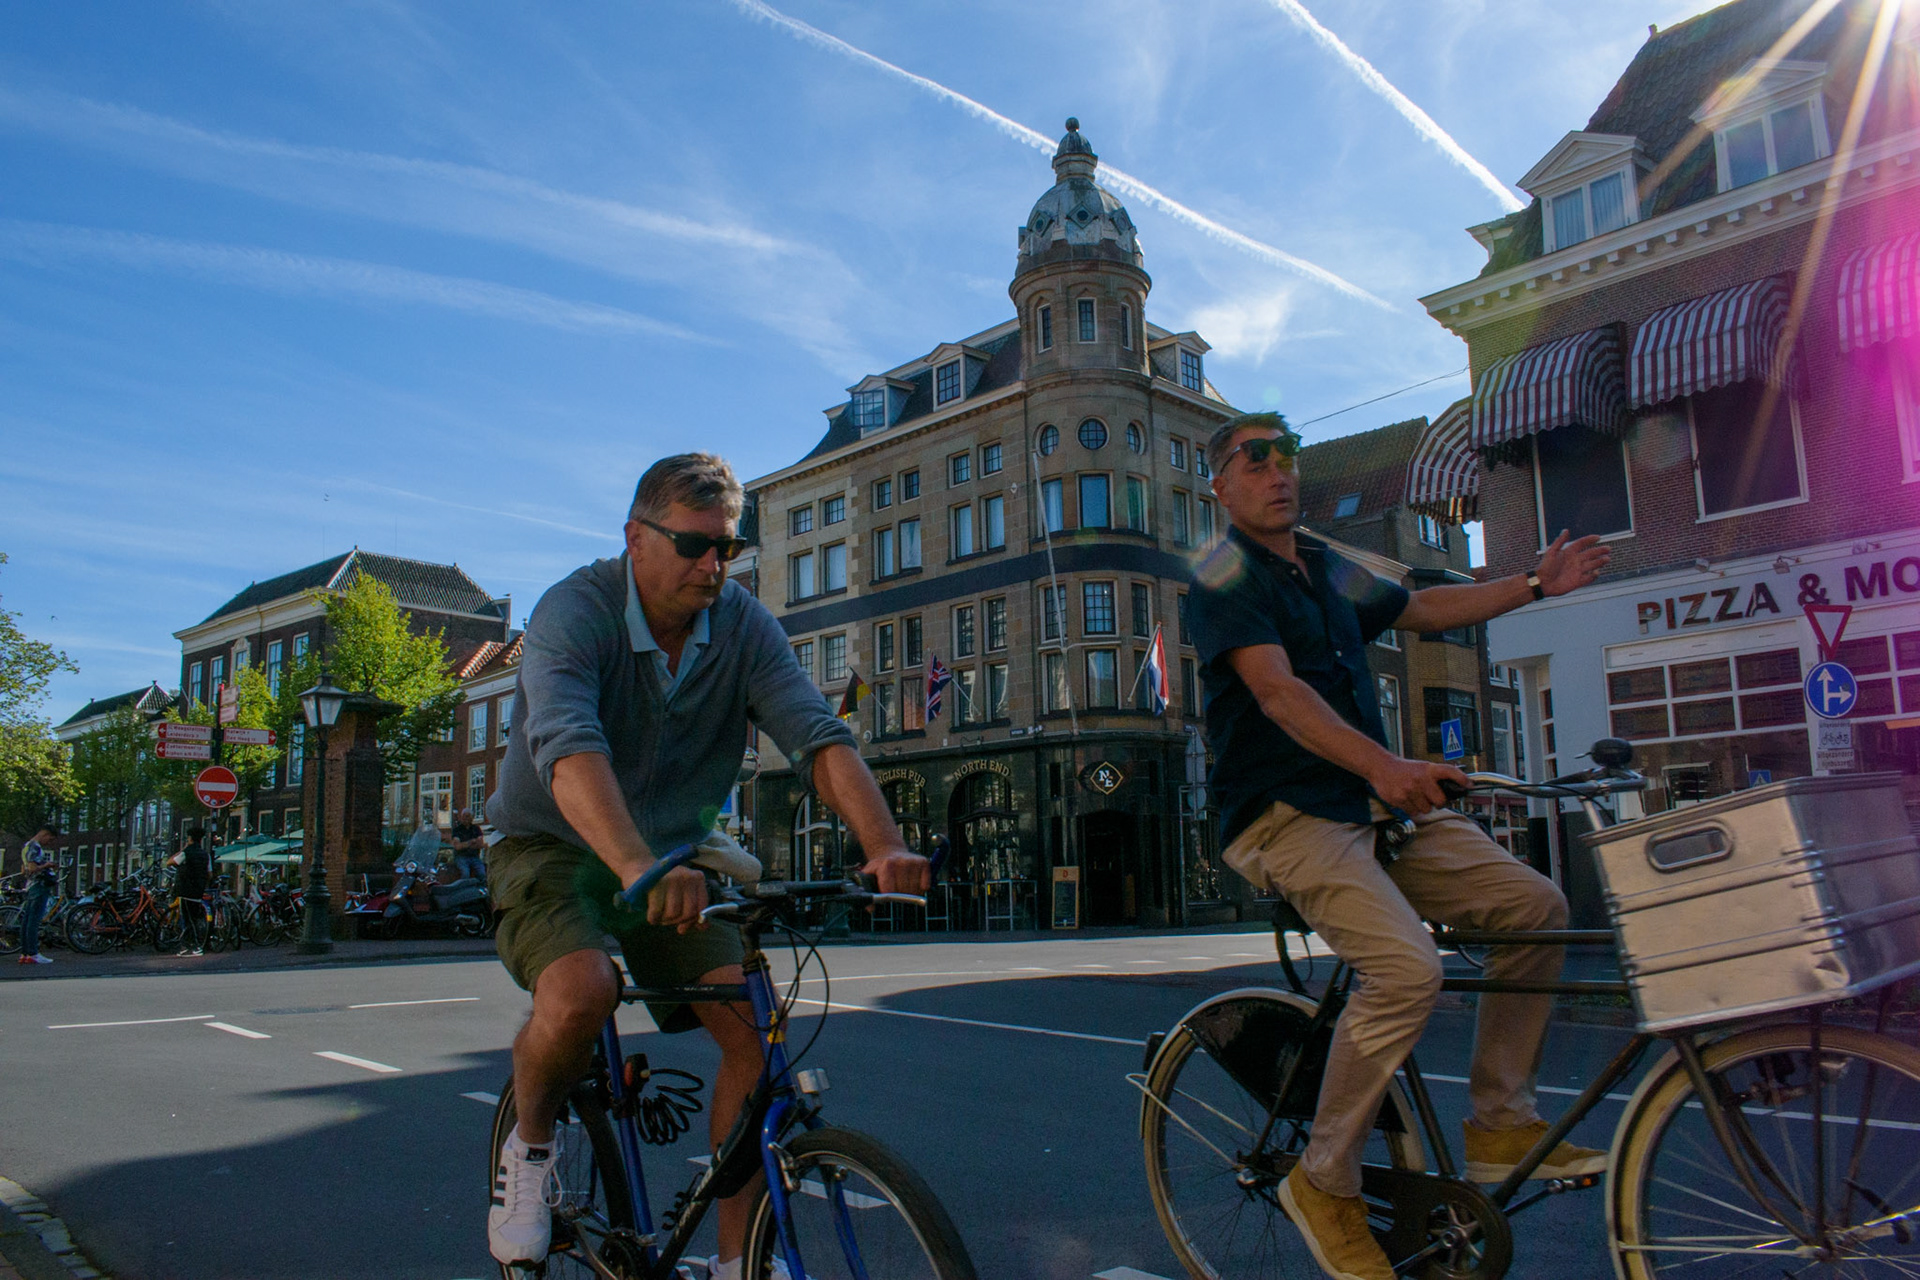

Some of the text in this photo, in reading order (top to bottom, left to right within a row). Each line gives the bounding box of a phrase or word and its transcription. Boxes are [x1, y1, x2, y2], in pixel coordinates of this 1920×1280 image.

[1637, 582, 1781, 635] PIZZA
[1797, 573, 1830, 606] &
[876, 768, 926, 788] NGLISH PUB
[953, 760, 1010, 780] NORTH END
